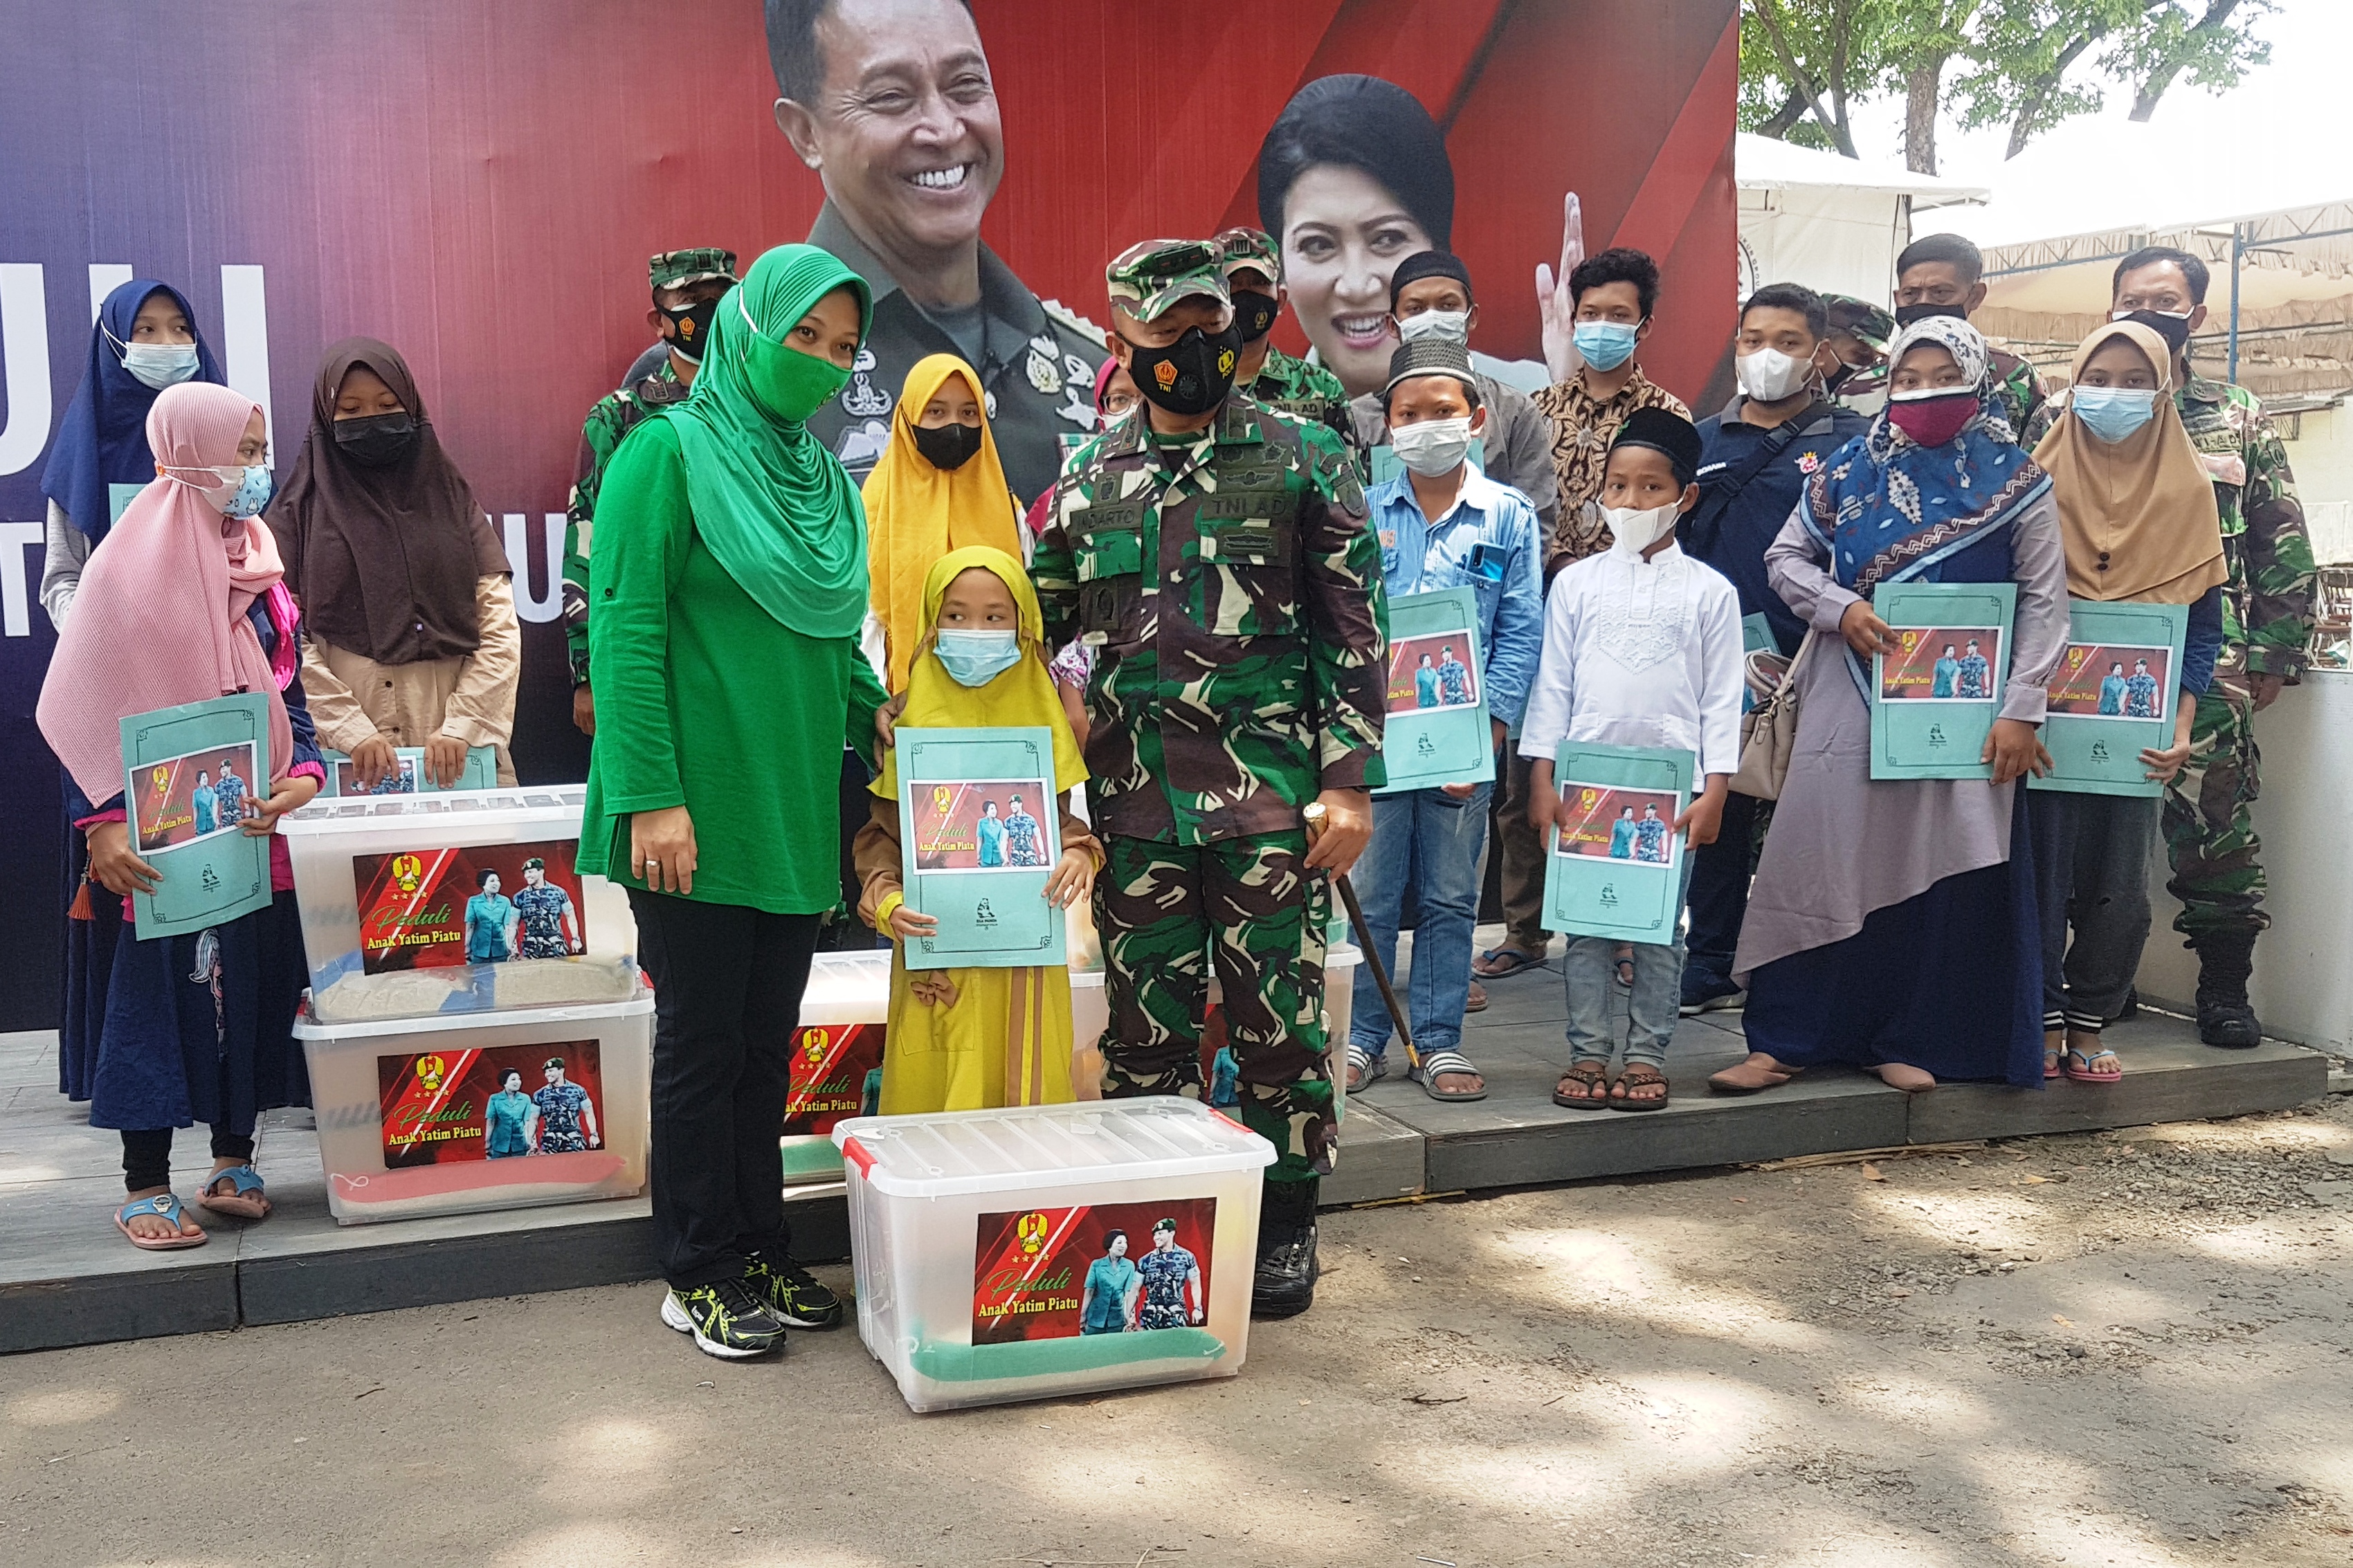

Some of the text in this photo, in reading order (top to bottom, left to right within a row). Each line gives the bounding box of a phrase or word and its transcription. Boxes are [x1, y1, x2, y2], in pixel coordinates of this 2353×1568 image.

[1159, 382, 1171, 393] TNI
[1302, 403, 1318, 413] AD
[1212, 497, 1286, 515] TNI AD
[143, 815, 192, 834] Anak Yatim Piatu
[919, 841, 974, 851] Anak Yatim Piatu
[372, 903, 452, 935] Peduli
[367, 930, 461, 950] Anak Yatim Piatu
[393, 1100, 473, 1131] Peduli
[785, 1099, 857, 1113] ak Yatim Piatu
[388, 1127, 482, 1146] Anak Yatim Piatu
[987, 1266, 1072, 1302] Peduli
[978, 1297, 1078, 1318] Anak Yatim Piatu
